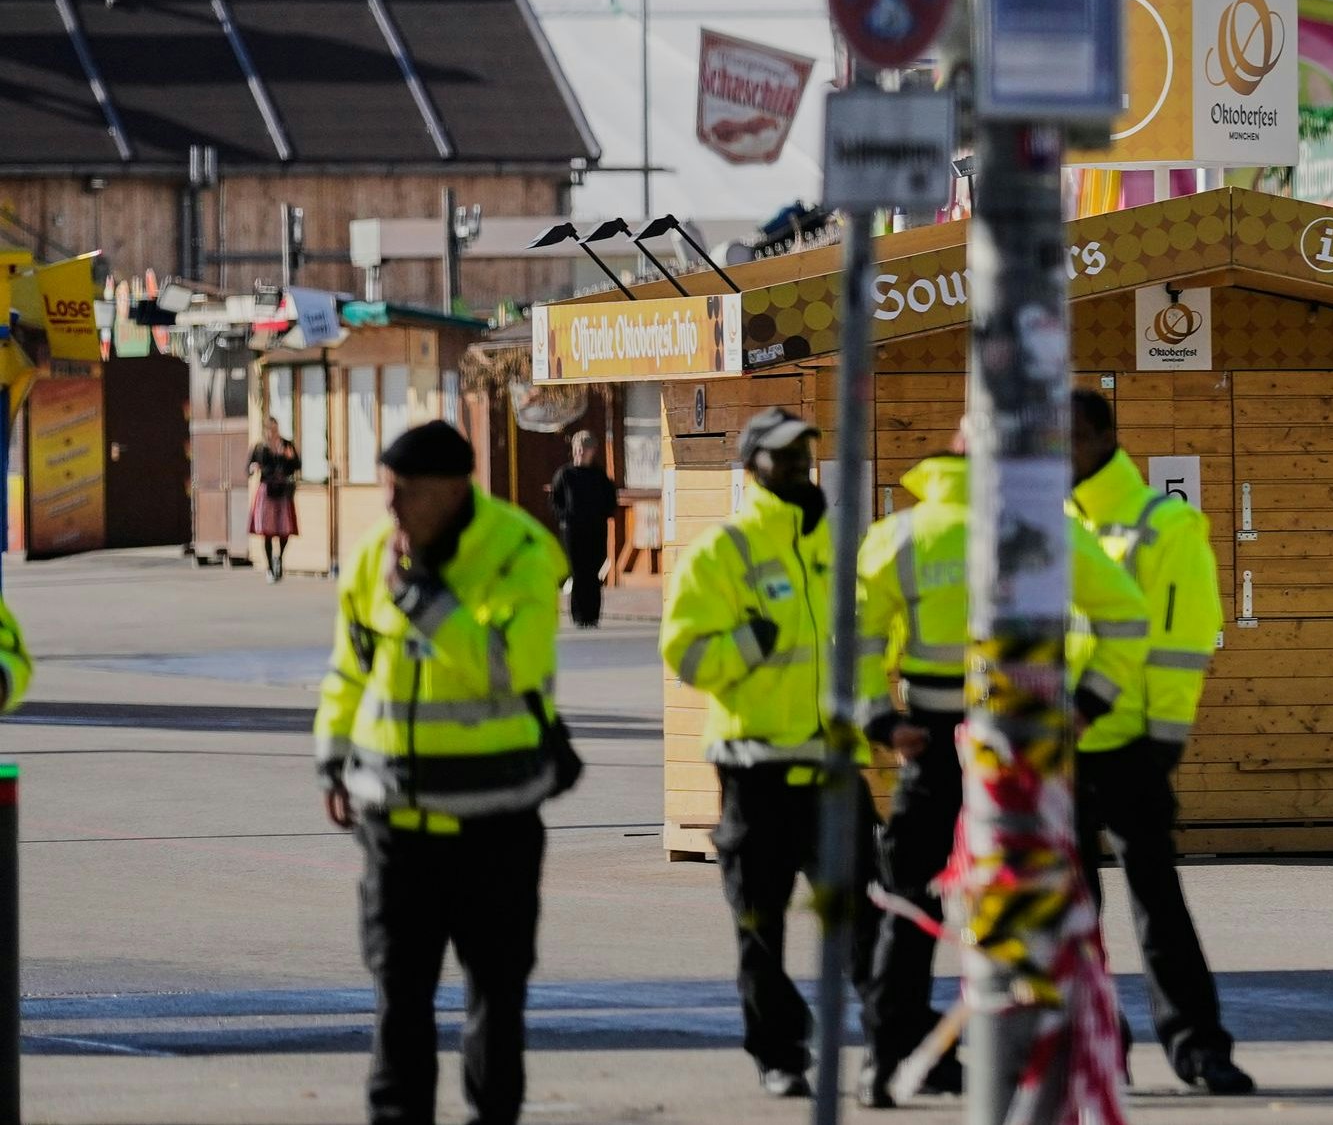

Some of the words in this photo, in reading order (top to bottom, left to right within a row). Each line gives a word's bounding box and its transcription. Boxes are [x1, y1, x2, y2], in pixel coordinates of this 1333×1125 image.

[1211, 102, 1278, 129] Oktoberfest
[45, 296, 91, 318] Lose
[1149, 347, 1197, 357] Oktoberfest
